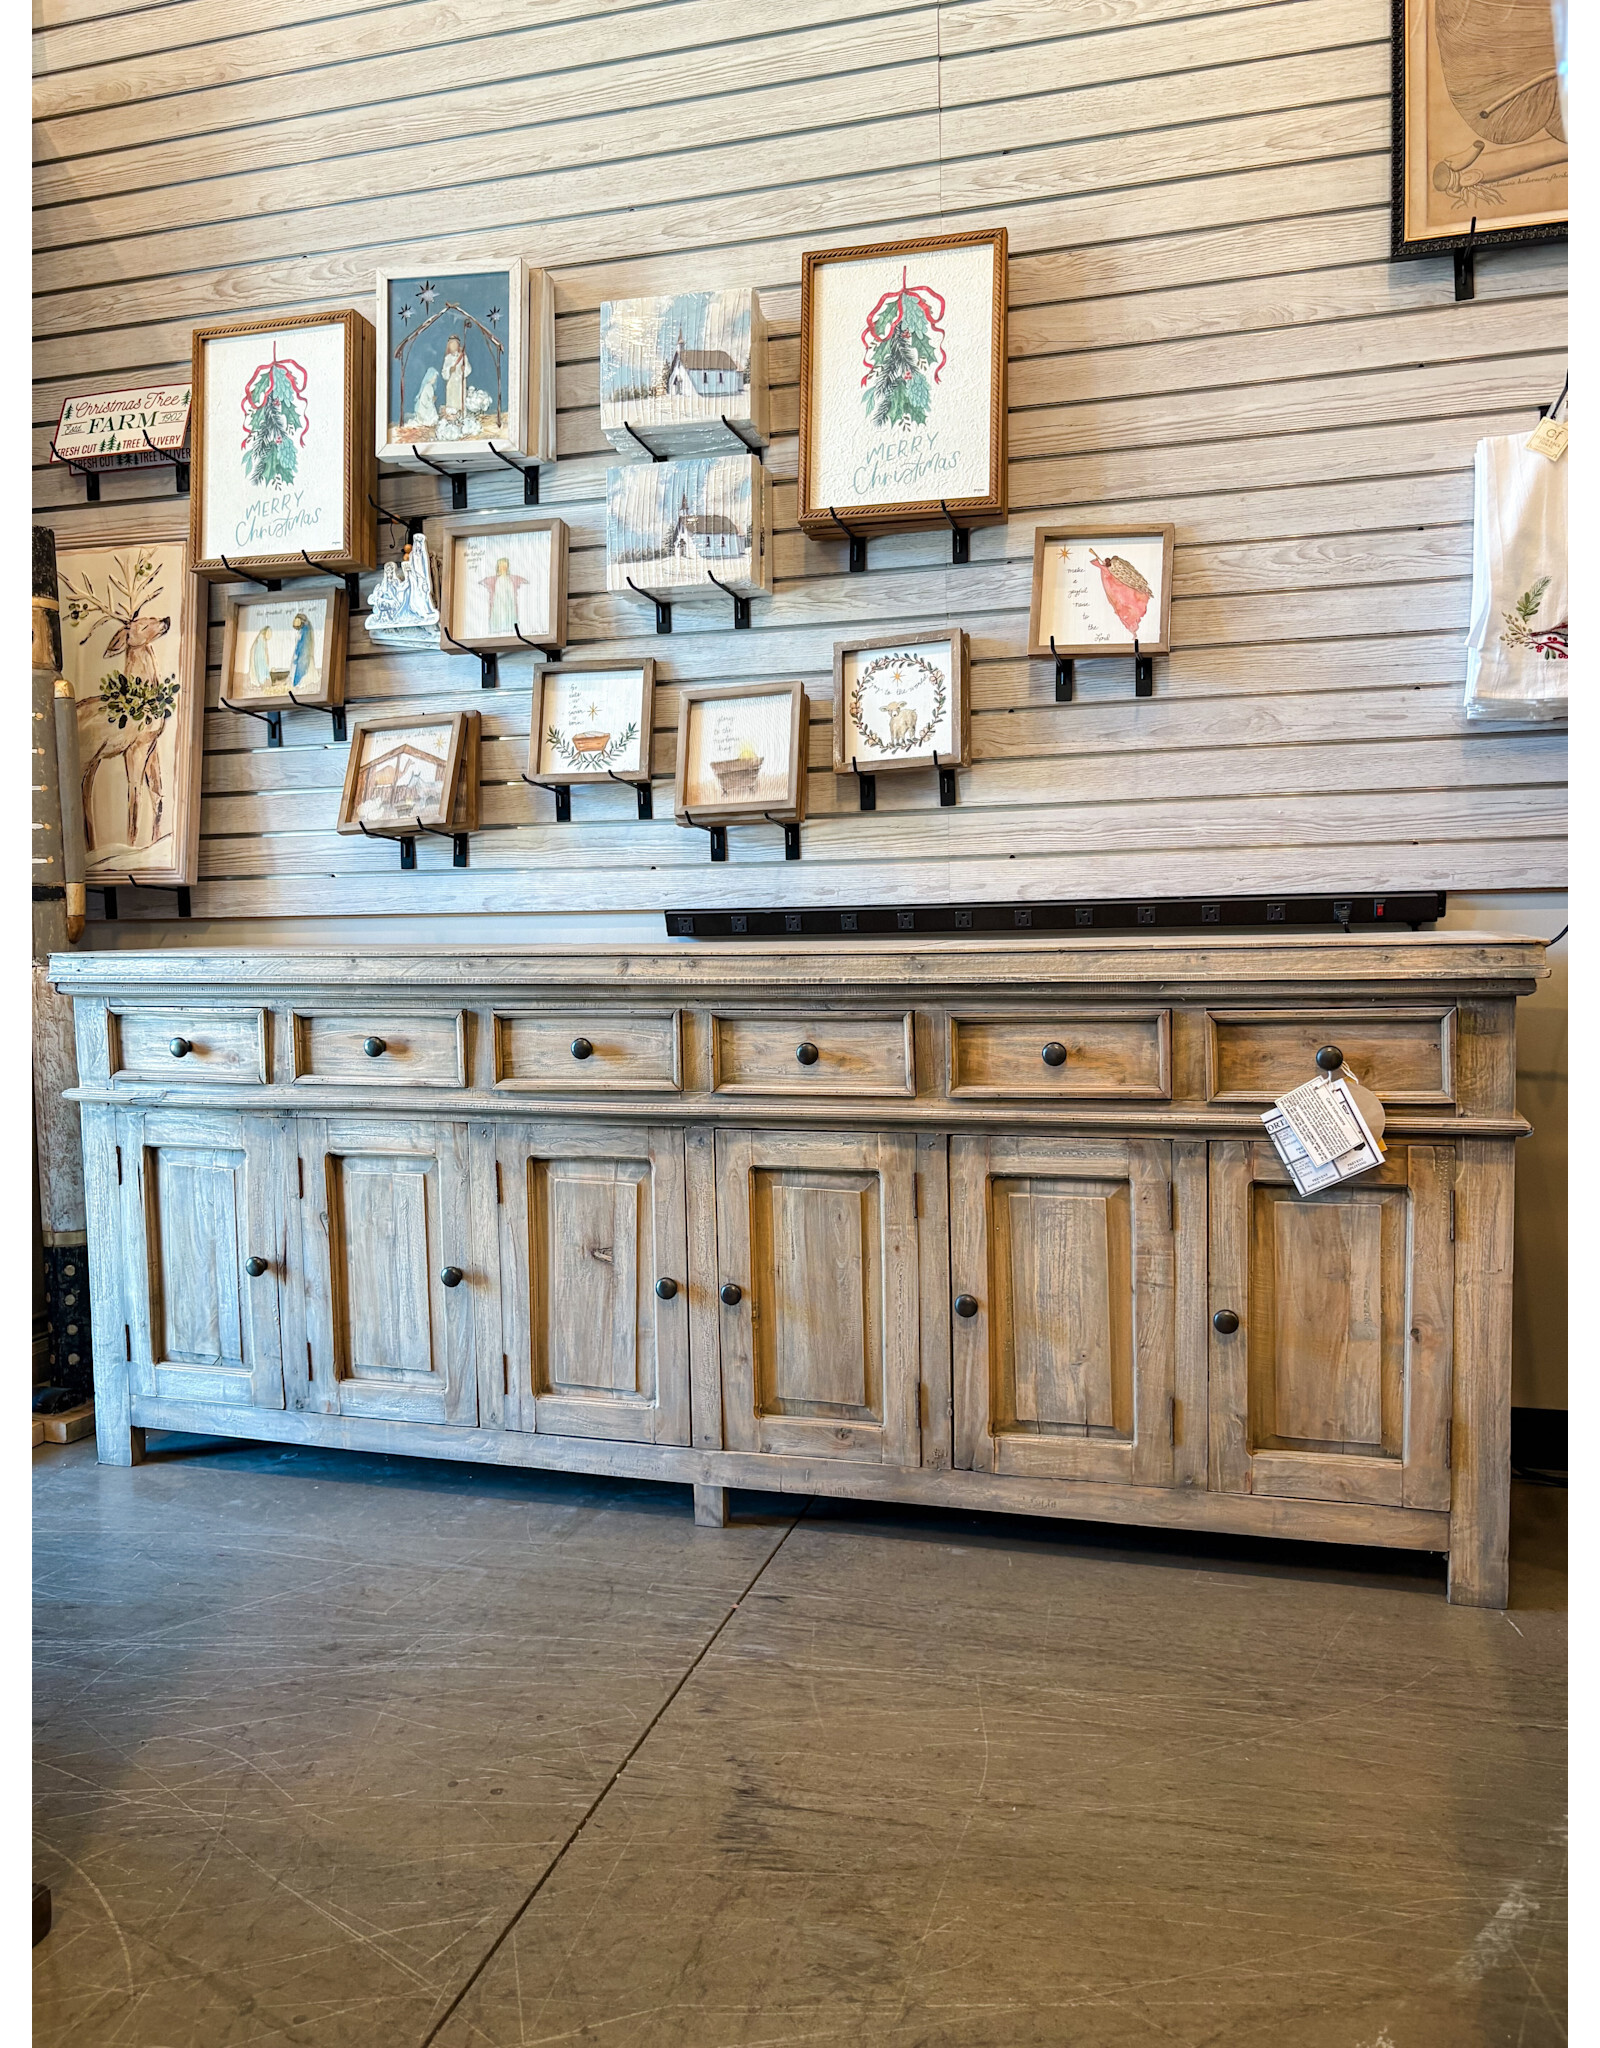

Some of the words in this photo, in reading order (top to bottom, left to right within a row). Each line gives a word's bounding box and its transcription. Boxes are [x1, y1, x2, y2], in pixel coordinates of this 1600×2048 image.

[76, 398, 141, 418] Christmas
[144, 392, 180, 413] Tree
[87, 411, 159, 434] FARM
[161, 412, 183, 422] 1902
[58, 446, 80, 457] FRESH
[82, 444, 98, 454] CUT
[122, 438, 142, 449] TREE
[142, 435, 181, 447] DELIVERY
[866, 432, 939, 464] MERRY
[100, 456, 114, 467] CUT
[140, 450, 158, 463] TREE
[160, 447, 191, 461] DELIVER
[853, 451, 960, 494] Christmas
[245, 490, 304, 520] MERRY
[235, 507, 322, 546] Christmas
[1087, 623, 1098, 631] the
